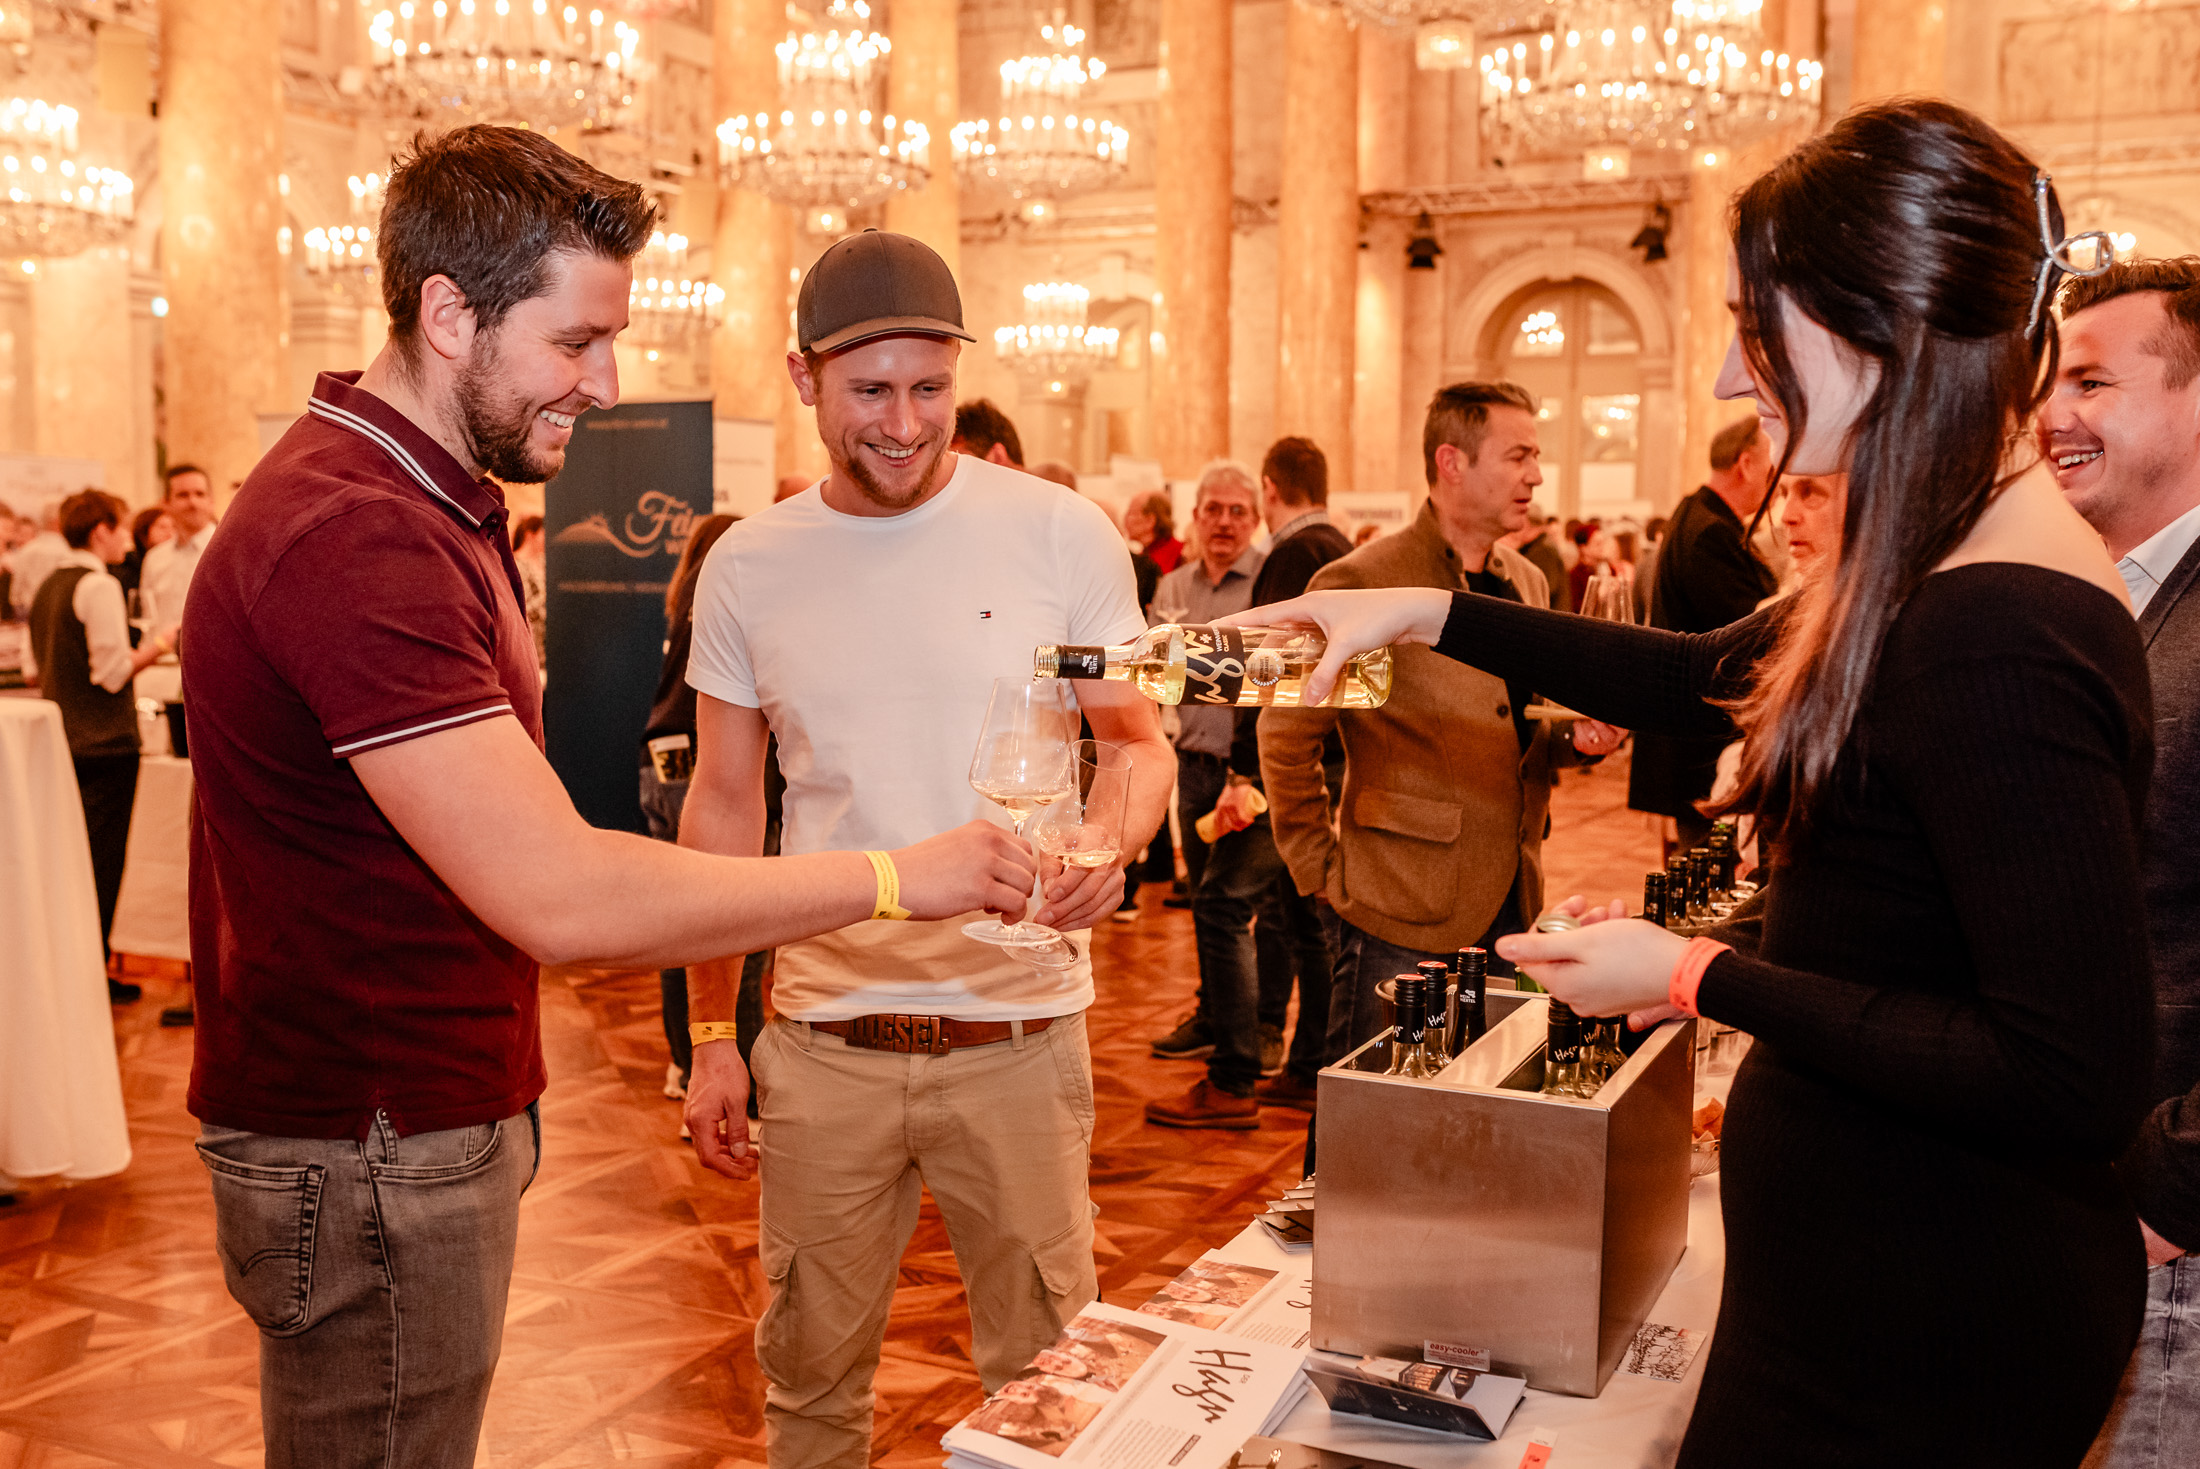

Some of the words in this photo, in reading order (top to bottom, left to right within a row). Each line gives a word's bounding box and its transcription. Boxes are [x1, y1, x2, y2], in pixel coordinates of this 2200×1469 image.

[845, 1014, 950, 1055] DIESEL
[1430, 1343, 1479, 1357] easy-cooler
[1172, 1349, 1254, 1424] Hagn
